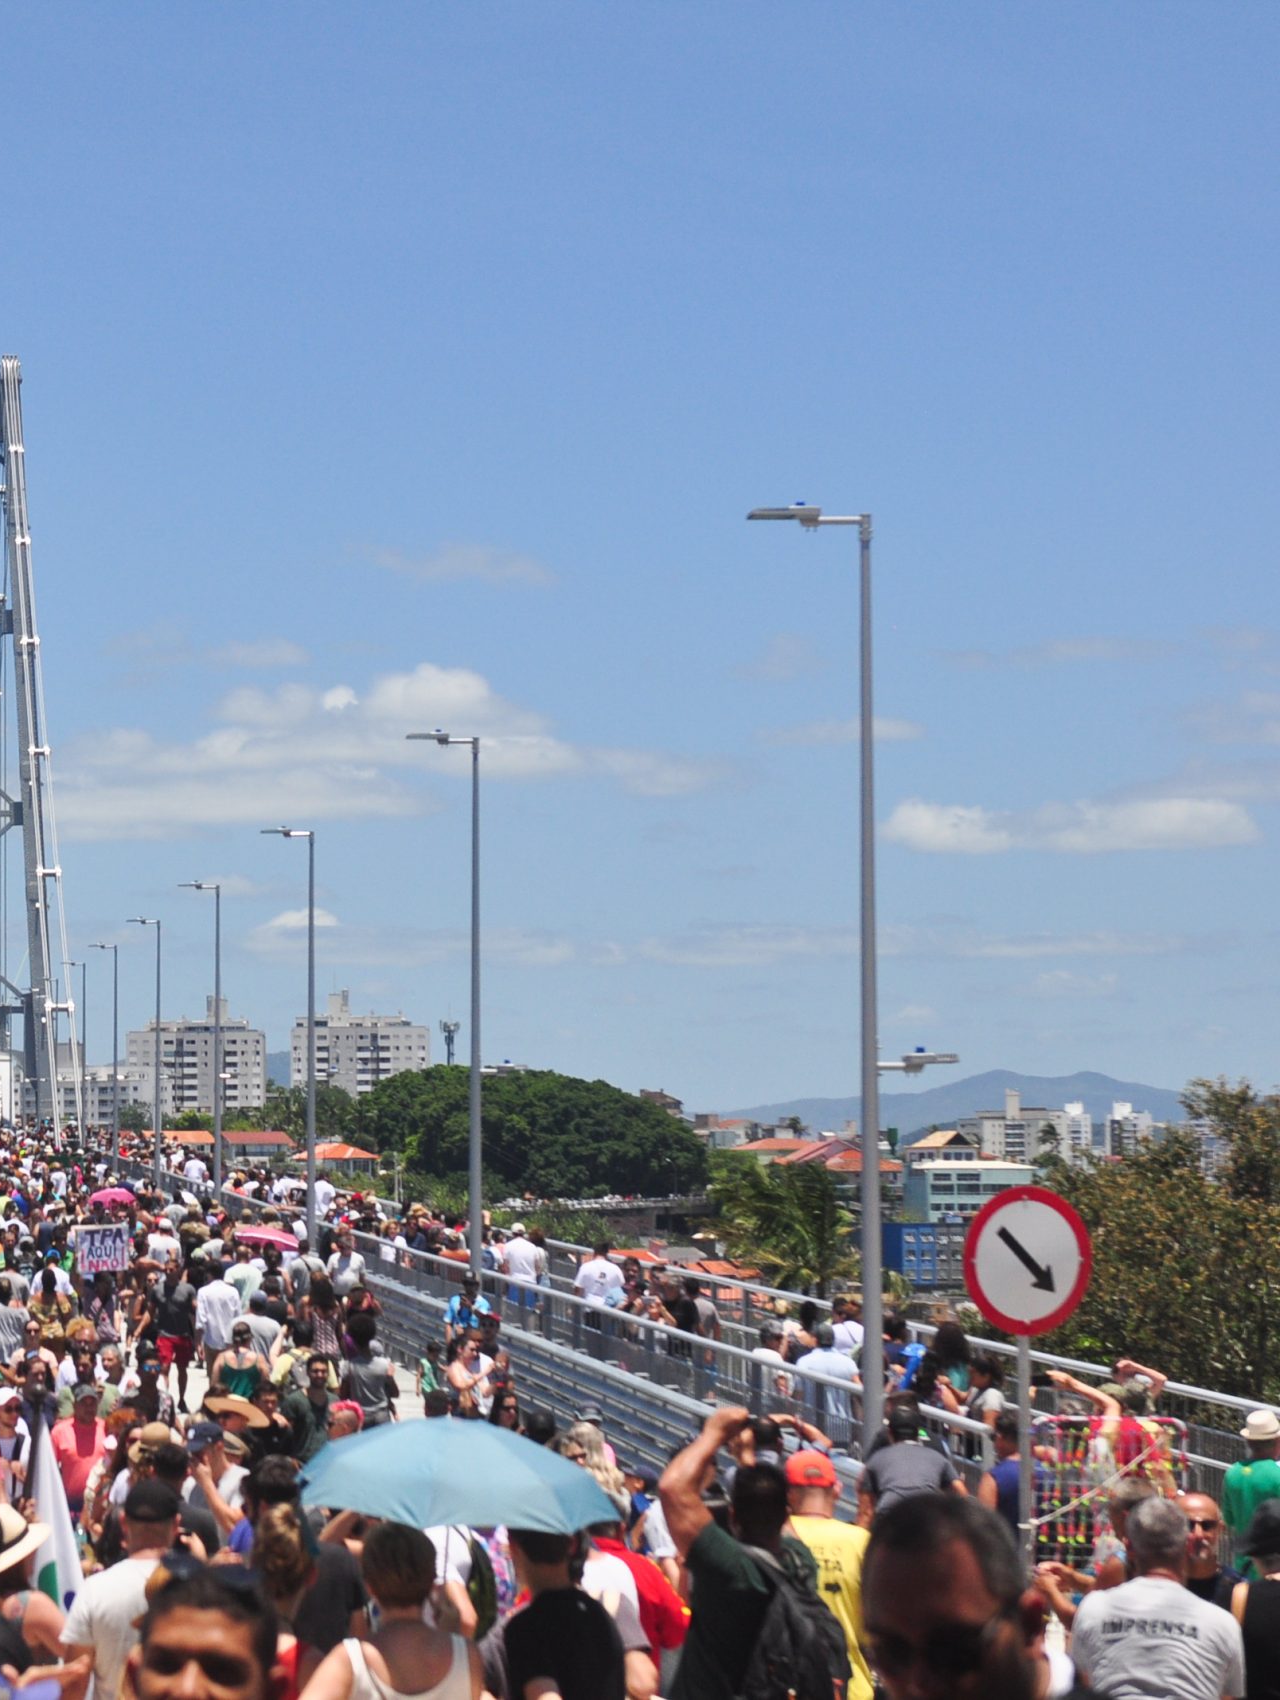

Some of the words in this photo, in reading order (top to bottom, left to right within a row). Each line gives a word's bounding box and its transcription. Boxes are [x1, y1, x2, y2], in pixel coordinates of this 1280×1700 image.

[85, 1228, 125, 1246] TPA
[86, 1245, 117, 1259] AQUI
[1101, 1618, 1198, 1640] IMPRENSA
